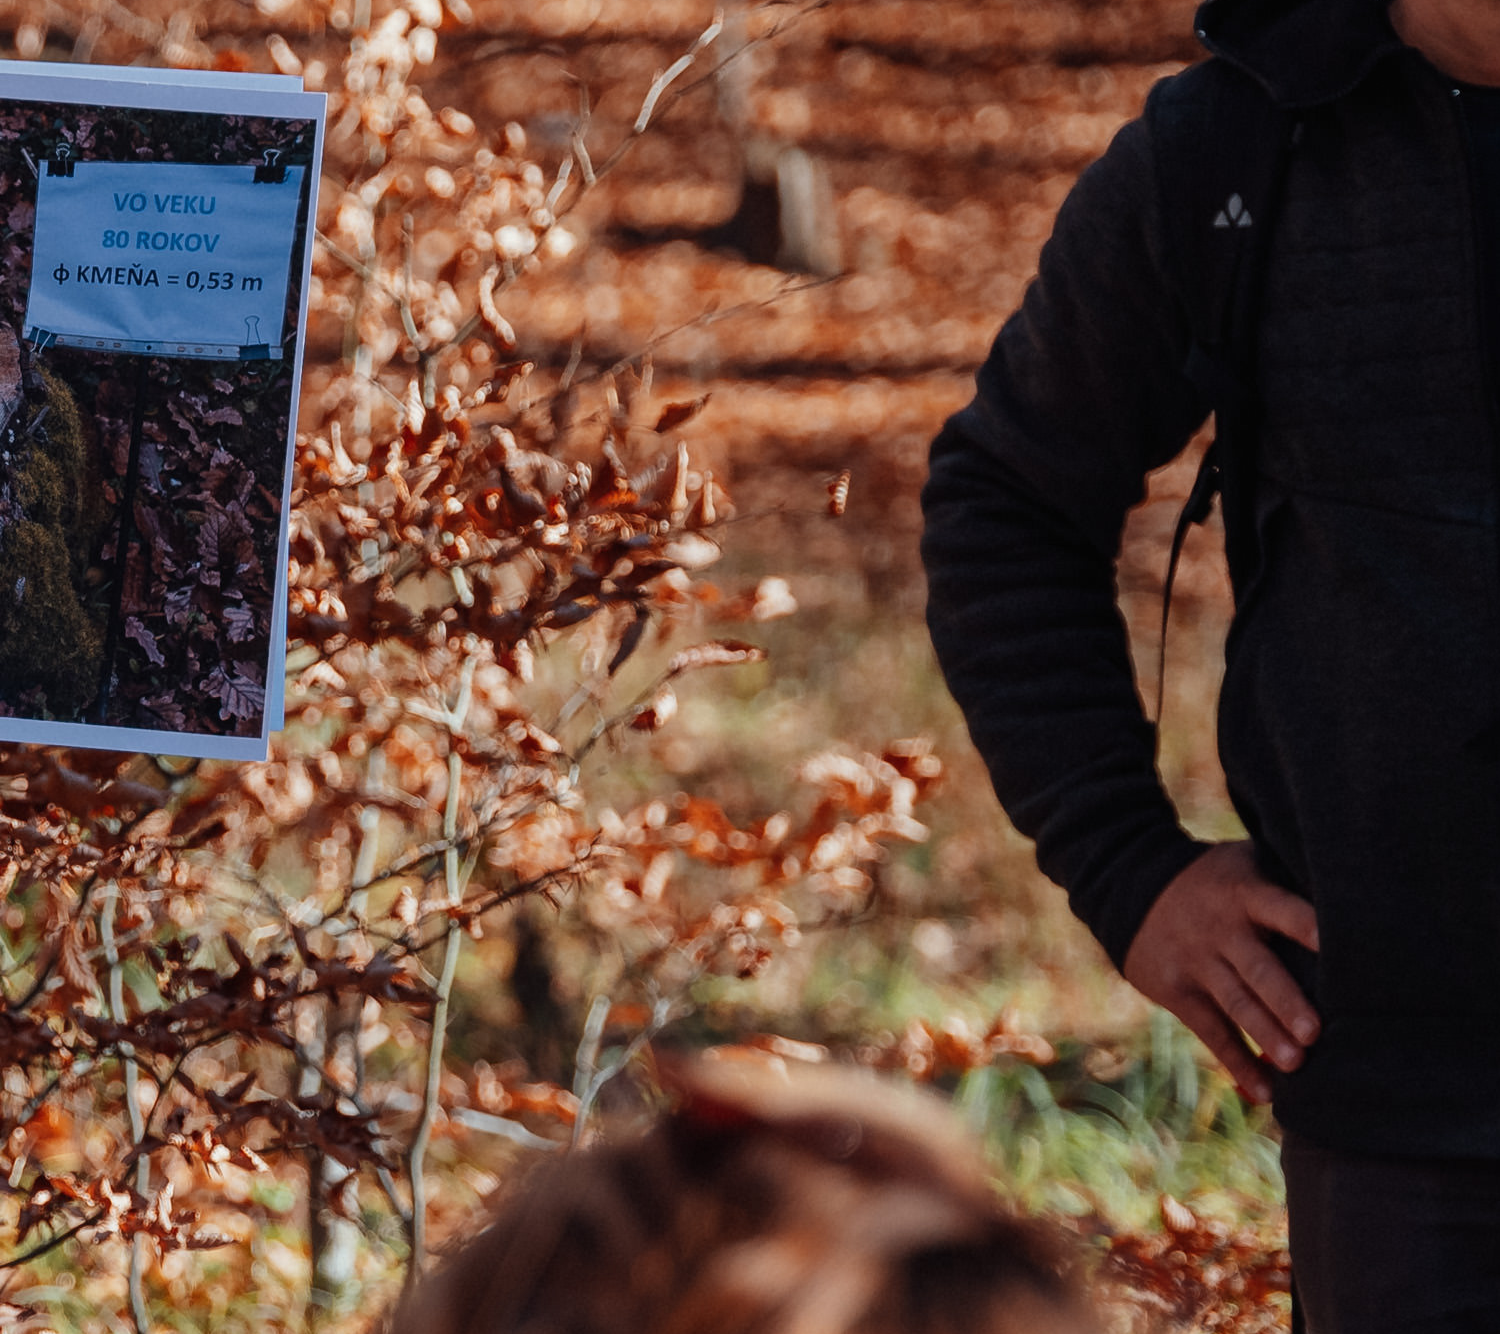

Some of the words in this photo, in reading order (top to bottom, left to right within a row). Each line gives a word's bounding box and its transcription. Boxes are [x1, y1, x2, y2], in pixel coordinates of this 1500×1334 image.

[113, 192, 147, 213] VO
[153, 193, 216, 215] VEKU
[102, 229, 130, 249] 80
[135, 230, 220, 253] ROKOV
[77, 263, 160, 287] KMEŇA
[166, 275, 180, 285] =
[186, 270, 234, 293] 0,53
[241, 275, 263, 291] m
